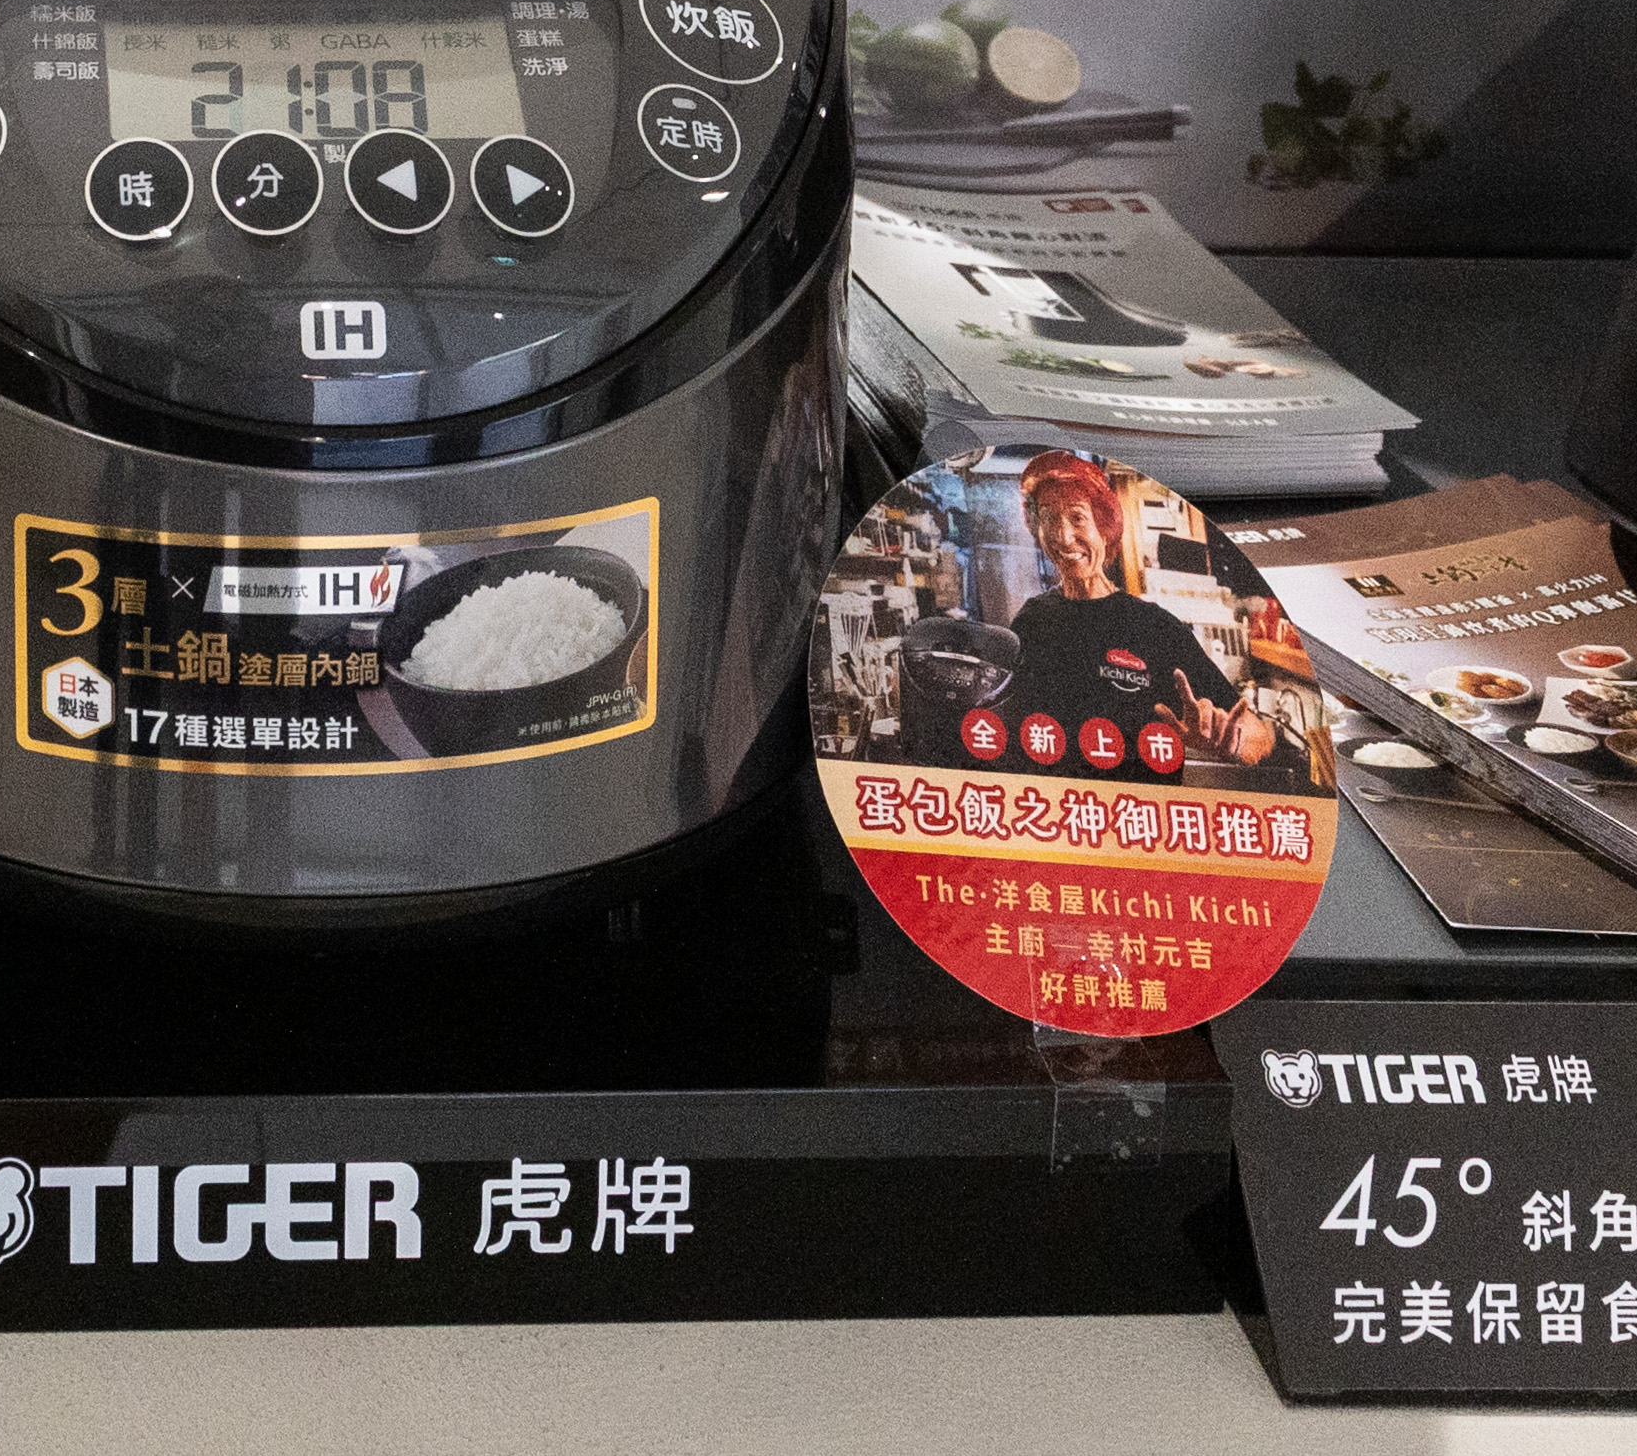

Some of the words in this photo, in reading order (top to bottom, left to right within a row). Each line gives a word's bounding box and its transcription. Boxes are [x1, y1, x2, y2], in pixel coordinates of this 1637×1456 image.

[31, 4, 96, 24] 糯米飯
[666, 0, 759, 47] 炊飯
[33, 31, 99, 52] 什錦飯
[321, 34, 391, 50] GABA
[516, 29, 564, 47] 蛋糕
[33, 61, 101, 81] 壽司飯
[522, 56, 569, 76] 洗淨
[191, 59, 429, 139] 21:08
[657, 117, 724, 154] 定時
[119, 171, 154, 208] 時
[247, 162, 283, 200] 分
[314, 309, 374, 353] IH
[1226, 530, 1270, 543] GER
[41, 548, 147, 636] 3層
[319, 573, 360, 606] IH
[58, 673, 99, 697] 日本
[1100, 666, 1124, 680] Kichi
[1126, 671, 1150, 687] Kichi
[57, 699, 100, 723] 製造
[124, 709, 358, 750] 17種選單設計
[971, 719, 1174, 764] 全新上市
[858, 778, 1312, 860] 蛋包飯之神御用推薦
[1190, 896, 1273, 929] Kichi
[1040, 972, 1169, 1013] 好評推薦
[1320, 1053, 1486, 1105] TIGER
[1502, 1053, 1598, 1105] 虎牌
[38, 1162, 421, 1264] TIGER
[473, 1157, 695, 1255] 虎牌
[1320, 1153, 1492, 1250] 45°
